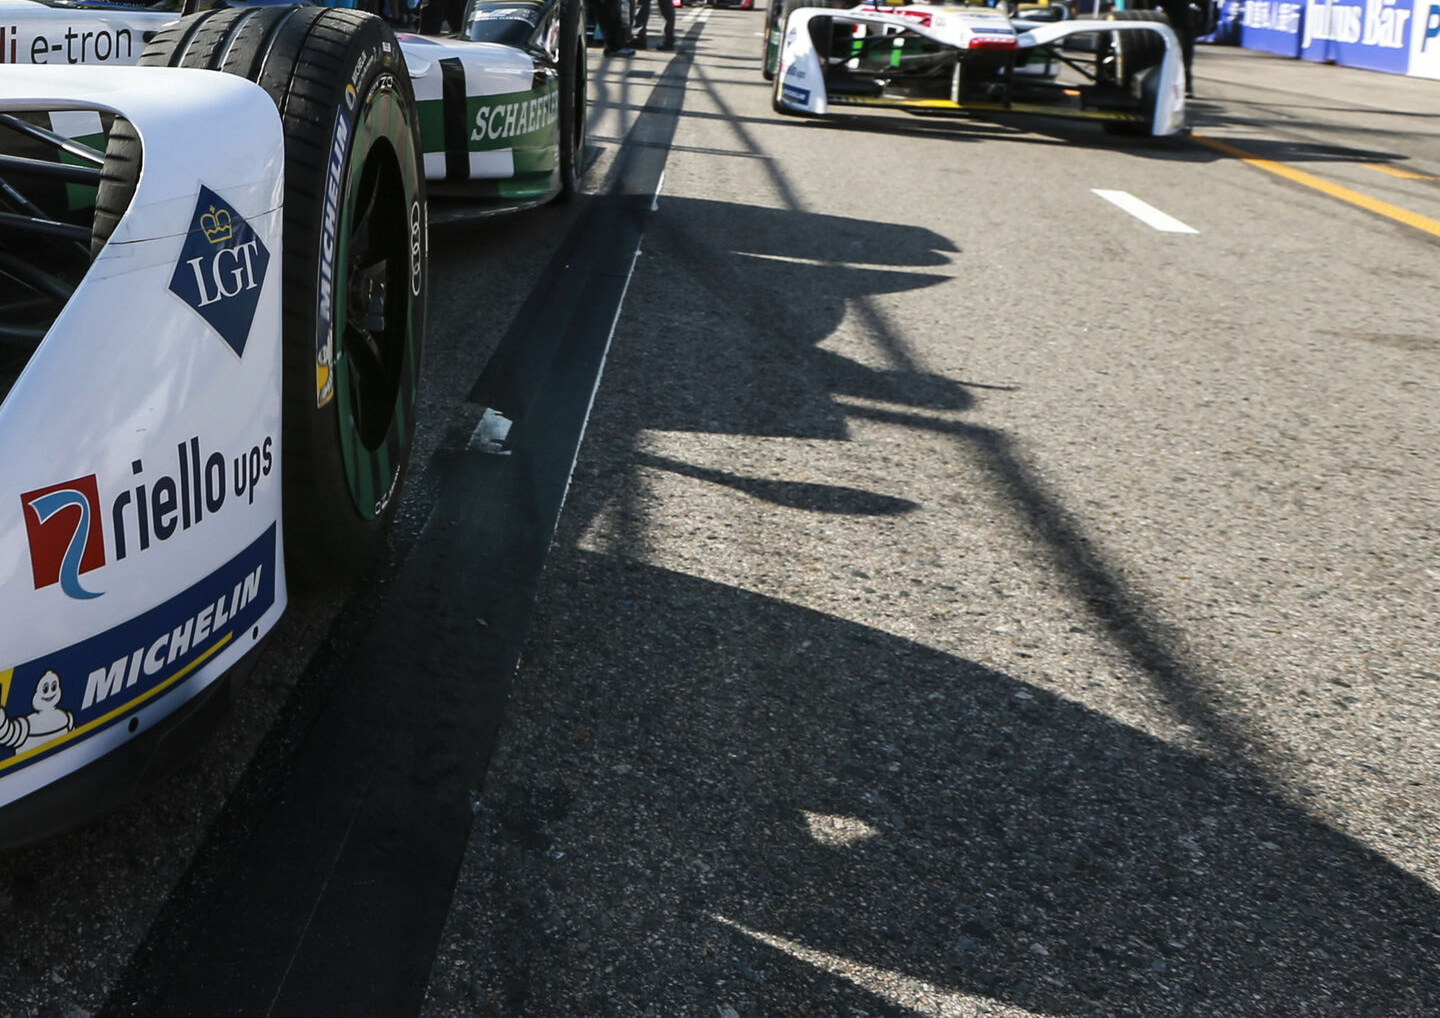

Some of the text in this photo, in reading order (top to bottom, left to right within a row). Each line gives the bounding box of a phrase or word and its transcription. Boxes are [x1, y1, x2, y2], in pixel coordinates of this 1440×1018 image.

[30, 27, 132, 64] e-tron
[186, 240, 259, 307] LGT
[320, 114, 348, 322] MICHELIN
[112, 436, 273, 561] riello ups
[81, 564, 262, 711] MICHELIN
